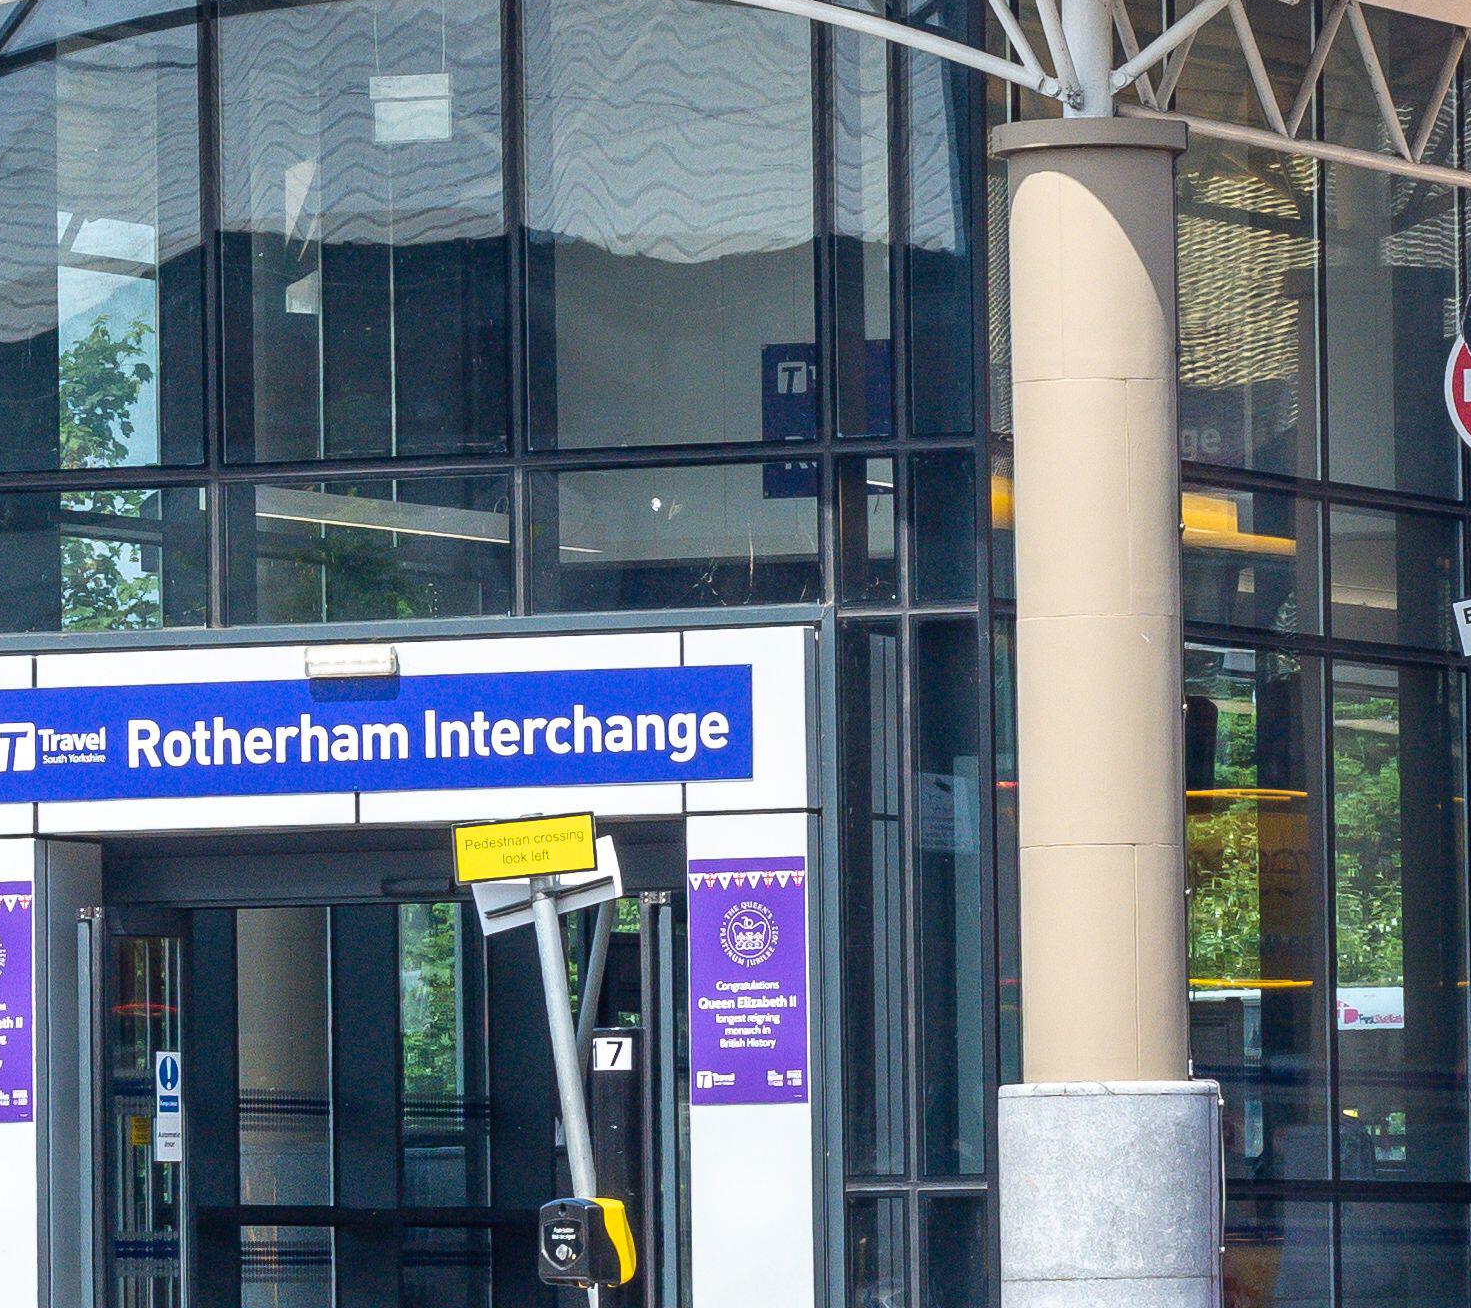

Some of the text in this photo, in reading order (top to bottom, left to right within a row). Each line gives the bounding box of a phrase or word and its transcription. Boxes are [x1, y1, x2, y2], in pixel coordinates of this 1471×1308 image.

[38, 726, 106, 752] Travel
[128, 705, 729, 768] Rotherham Interchange
[42, 754, 68, 764] South
[464, 830, 584, 850] Pedestrian crossing
[502, 850, 550, 864] look left
[716, 980, 780, 993] Congratulations
[698, 995, 797, 1010] Queen Elizabeth II
[16, 1016, 23, 1028] II
[716, 1013, 780, 1025] longest reigning
[725, 1025, 771, 1035] monarch in
[720, 1038, 776, 1049] British History
